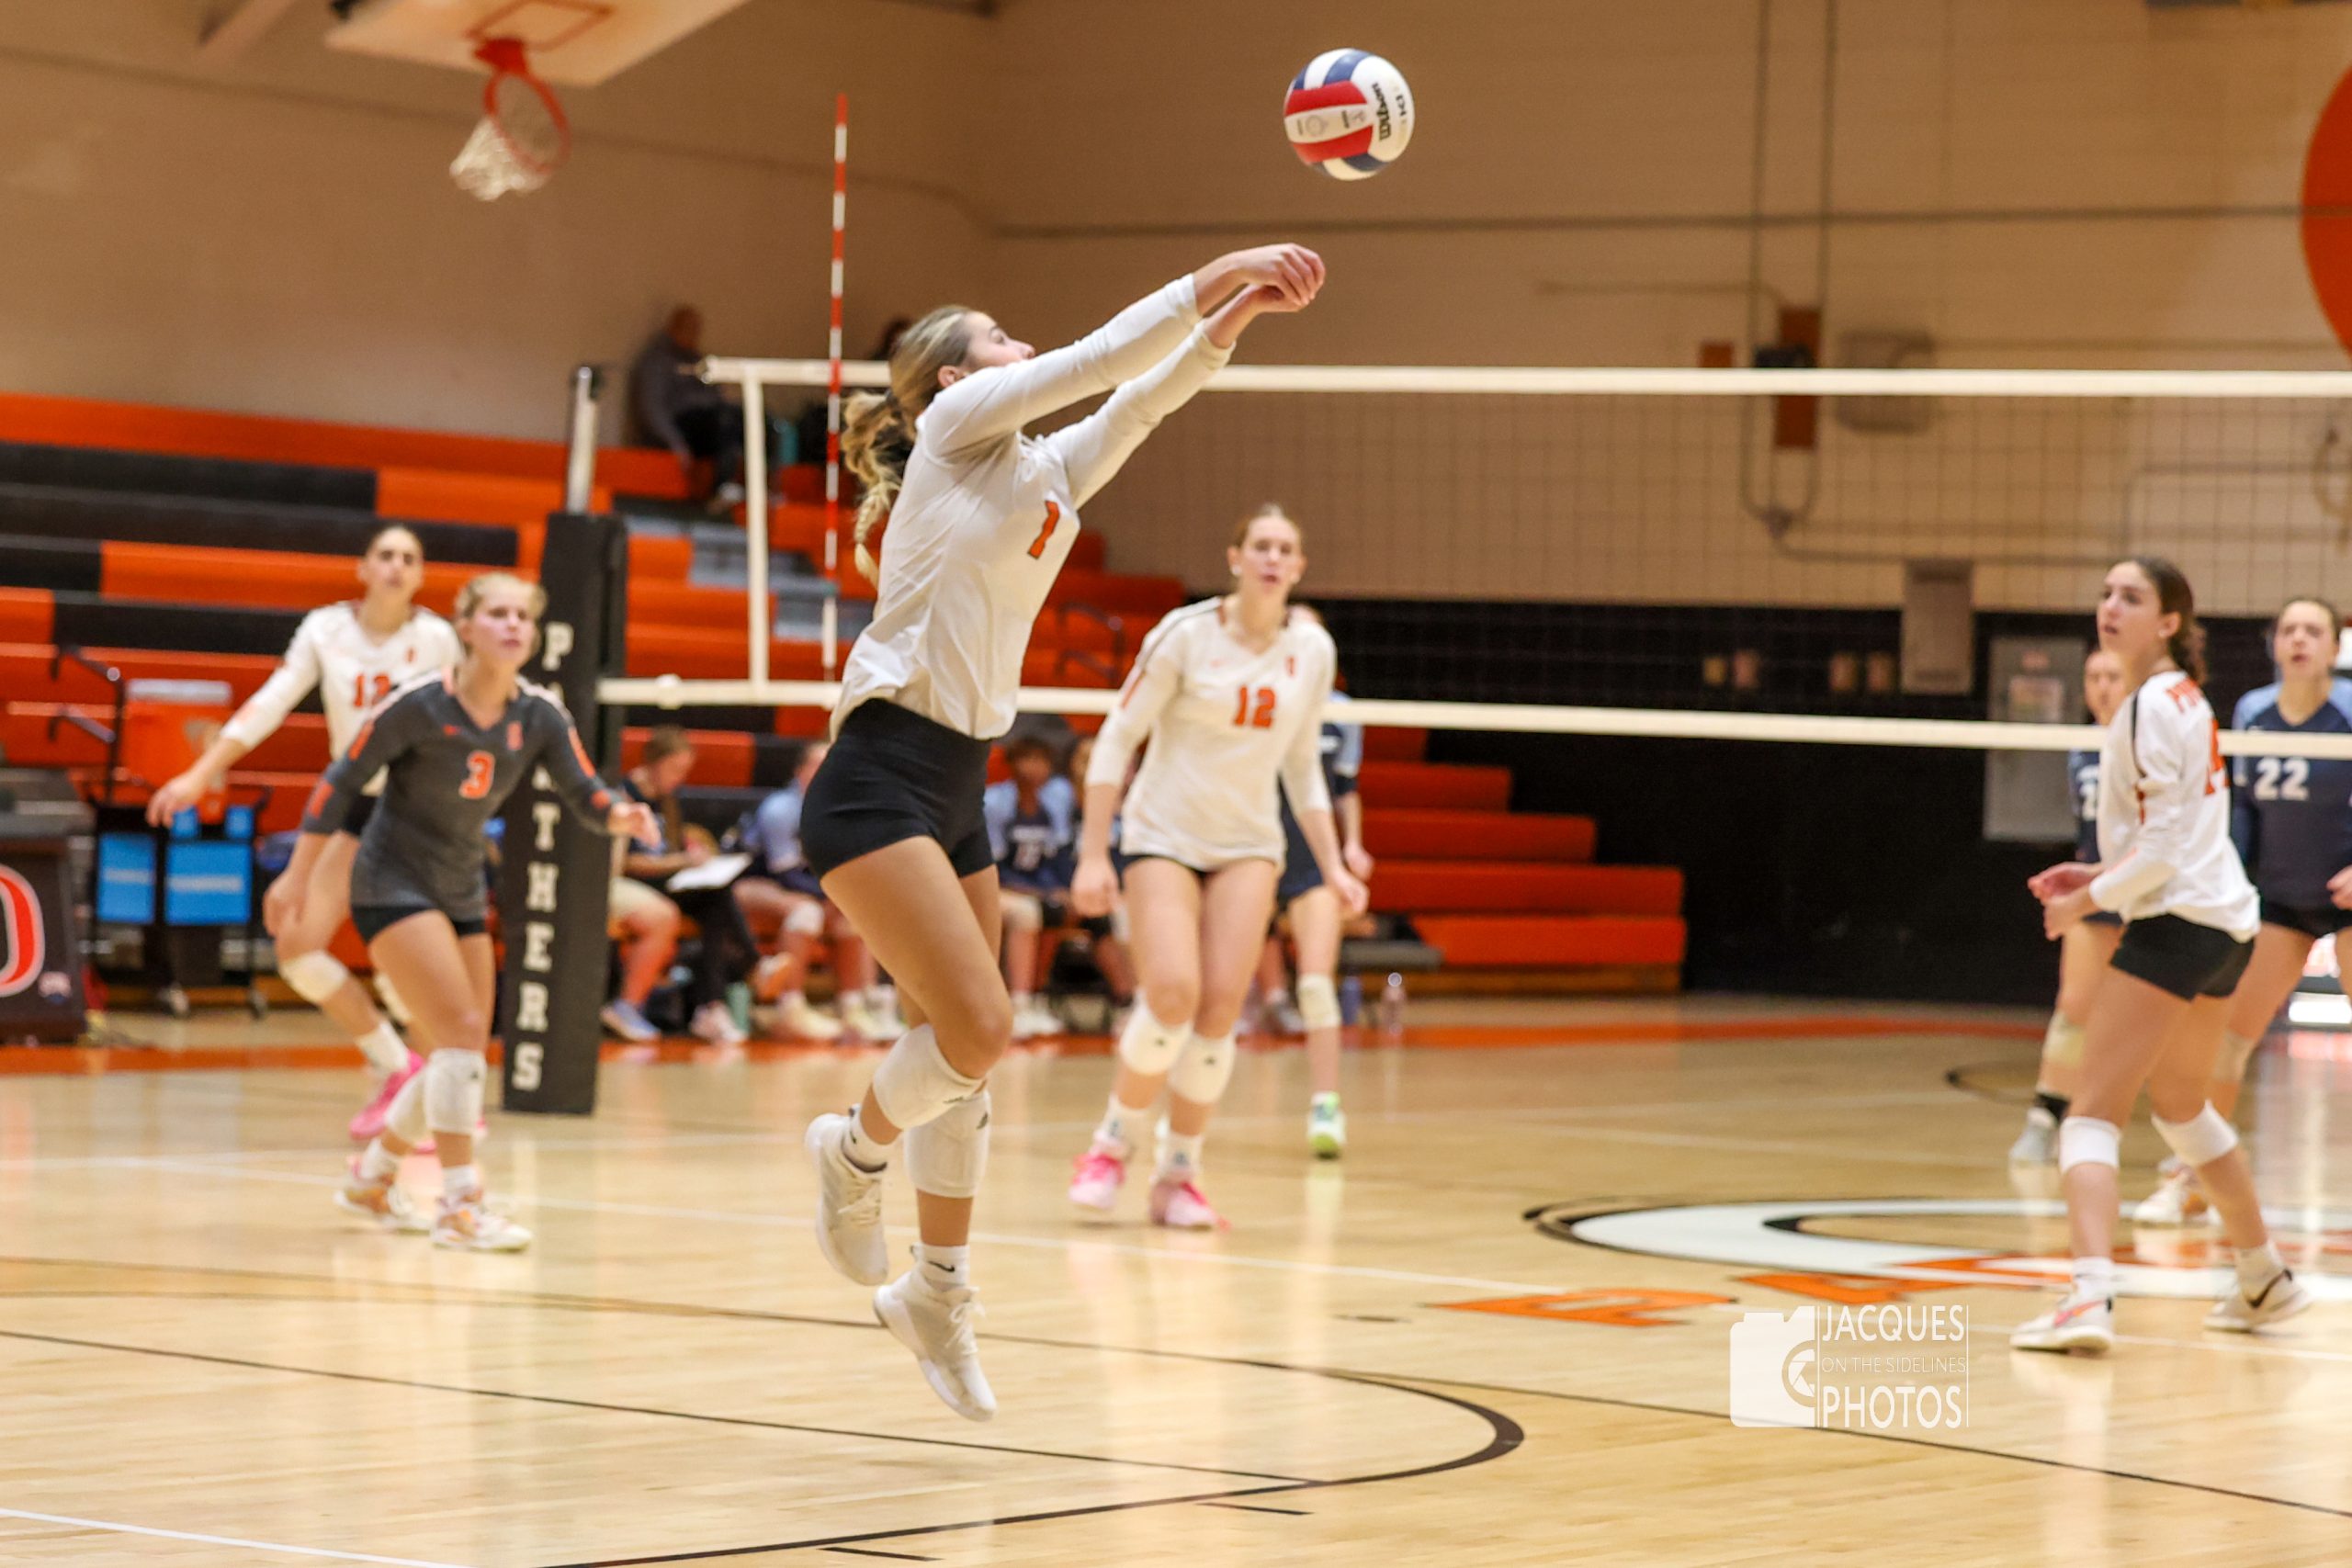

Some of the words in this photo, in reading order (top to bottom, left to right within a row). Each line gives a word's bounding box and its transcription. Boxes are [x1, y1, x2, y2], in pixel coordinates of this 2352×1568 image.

[1372, 83, 1391, 141] Wilson
[1027, 500, 1059, 559] 1
[1232, 685, 1276, 728] 12
[459, 750, 495, 799] 3
[2253, 757, 2311, 801] 22
[511, 622, 575, 1091] PTHERS
